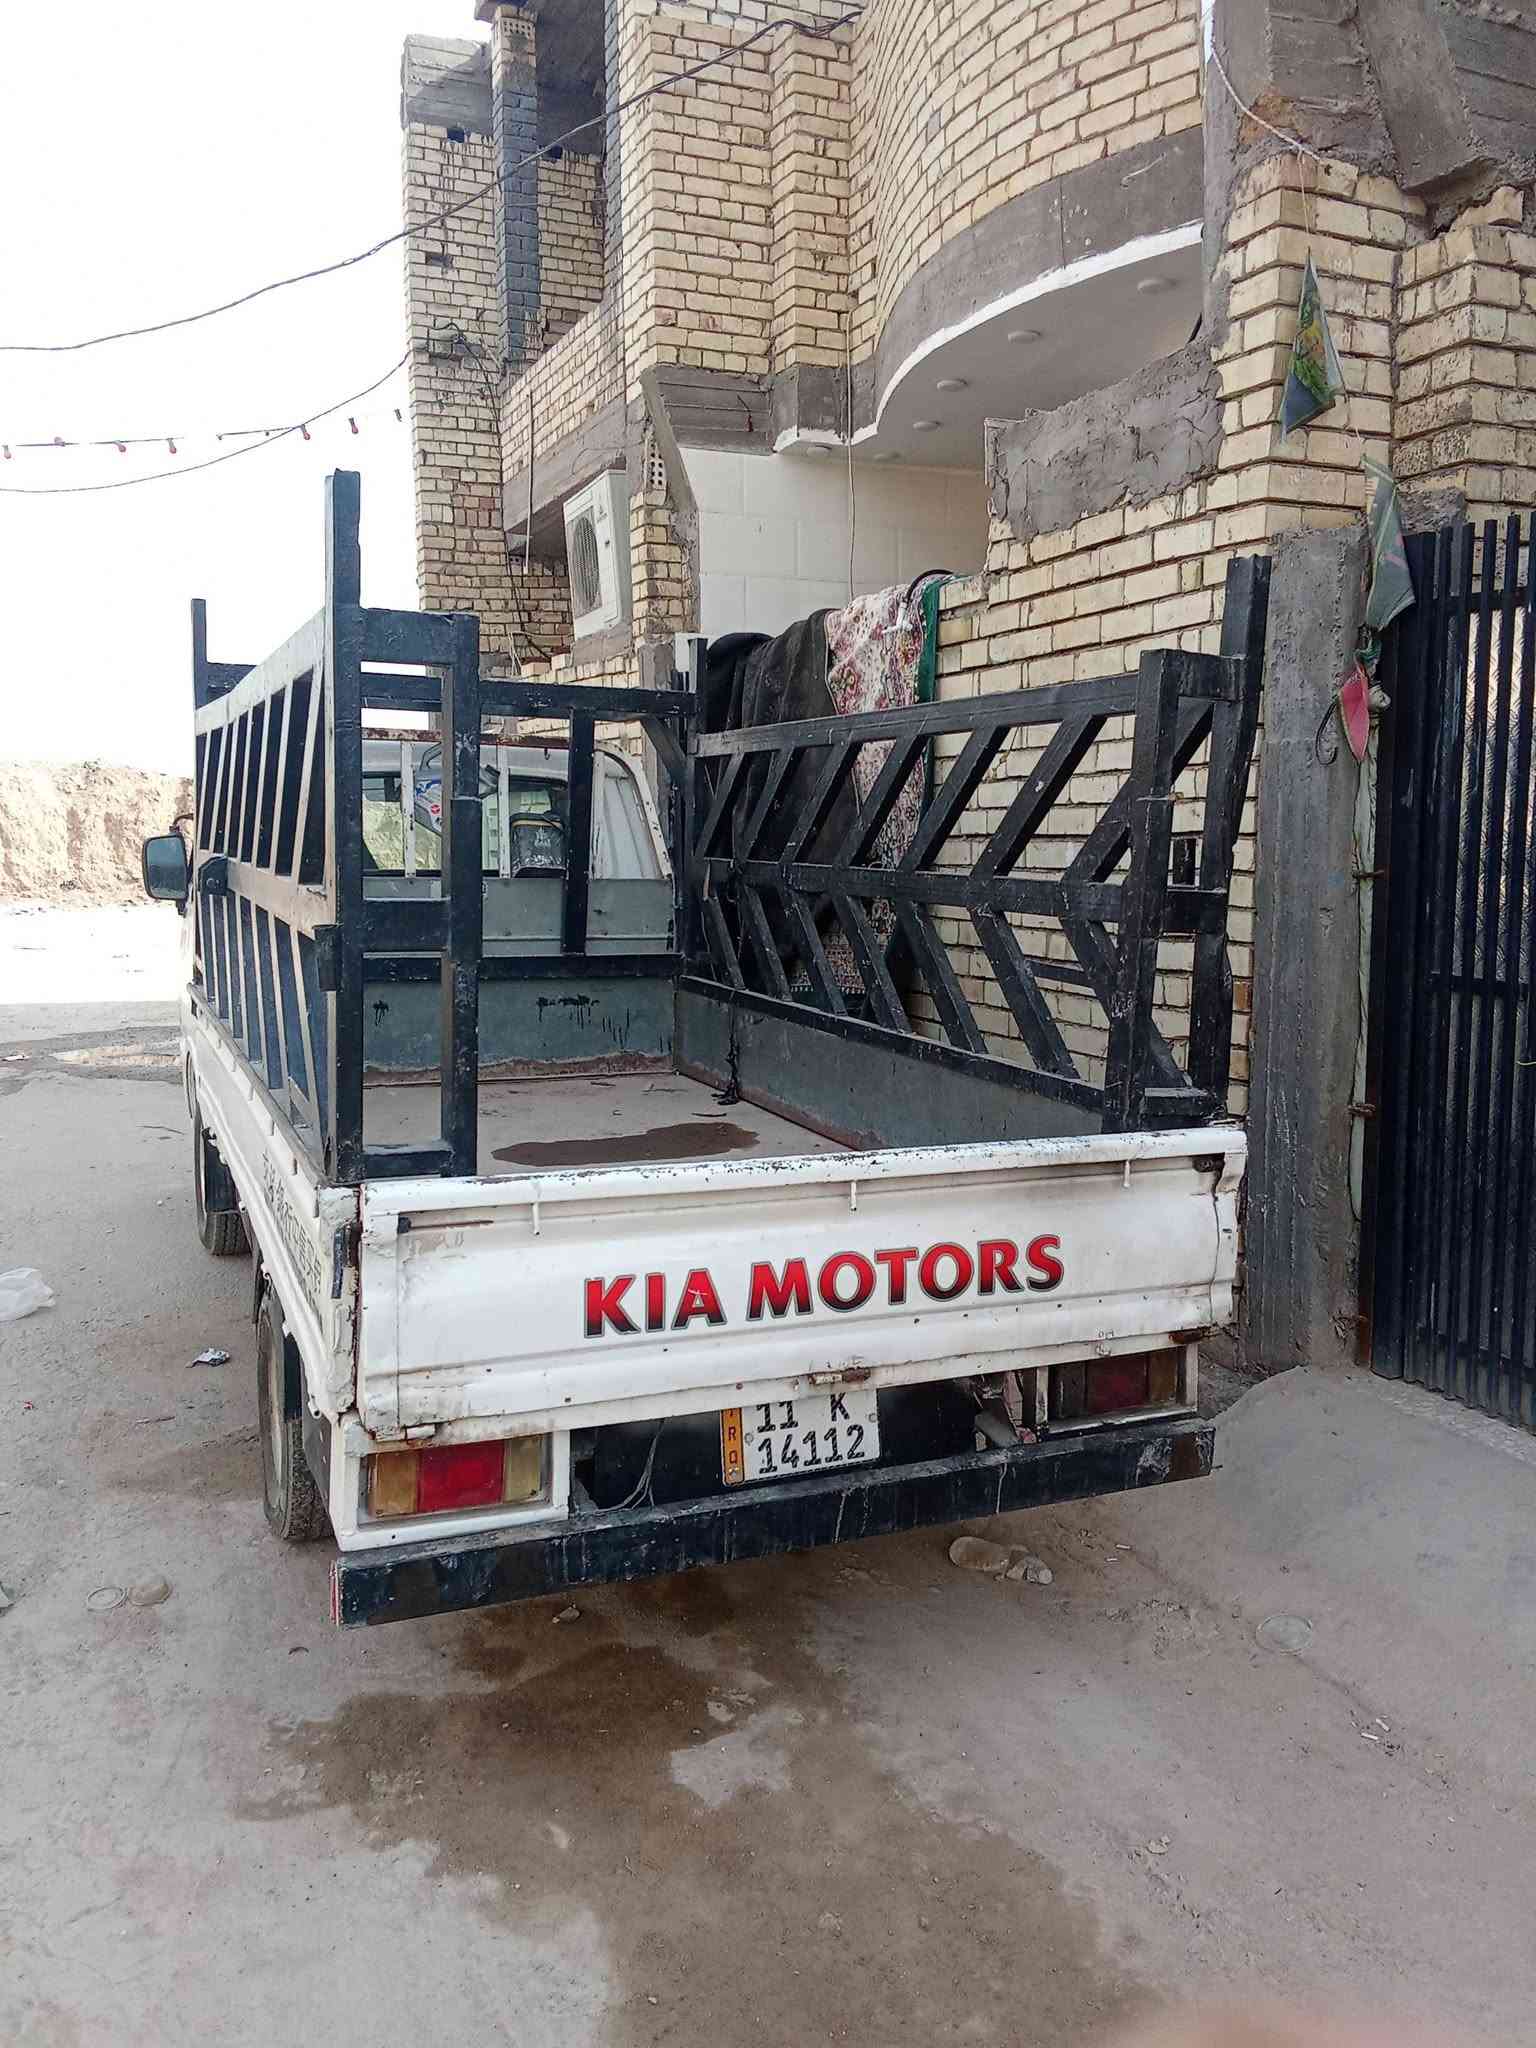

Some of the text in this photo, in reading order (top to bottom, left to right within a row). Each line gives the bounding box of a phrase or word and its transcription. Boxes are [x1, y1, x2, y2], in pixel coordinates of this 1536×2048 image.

[584, 1233, 1065, 1339] KIA MOTORS
[756, 1392, 850, 1433] 11 K
[758, 1424, 866, 1474] 14112
